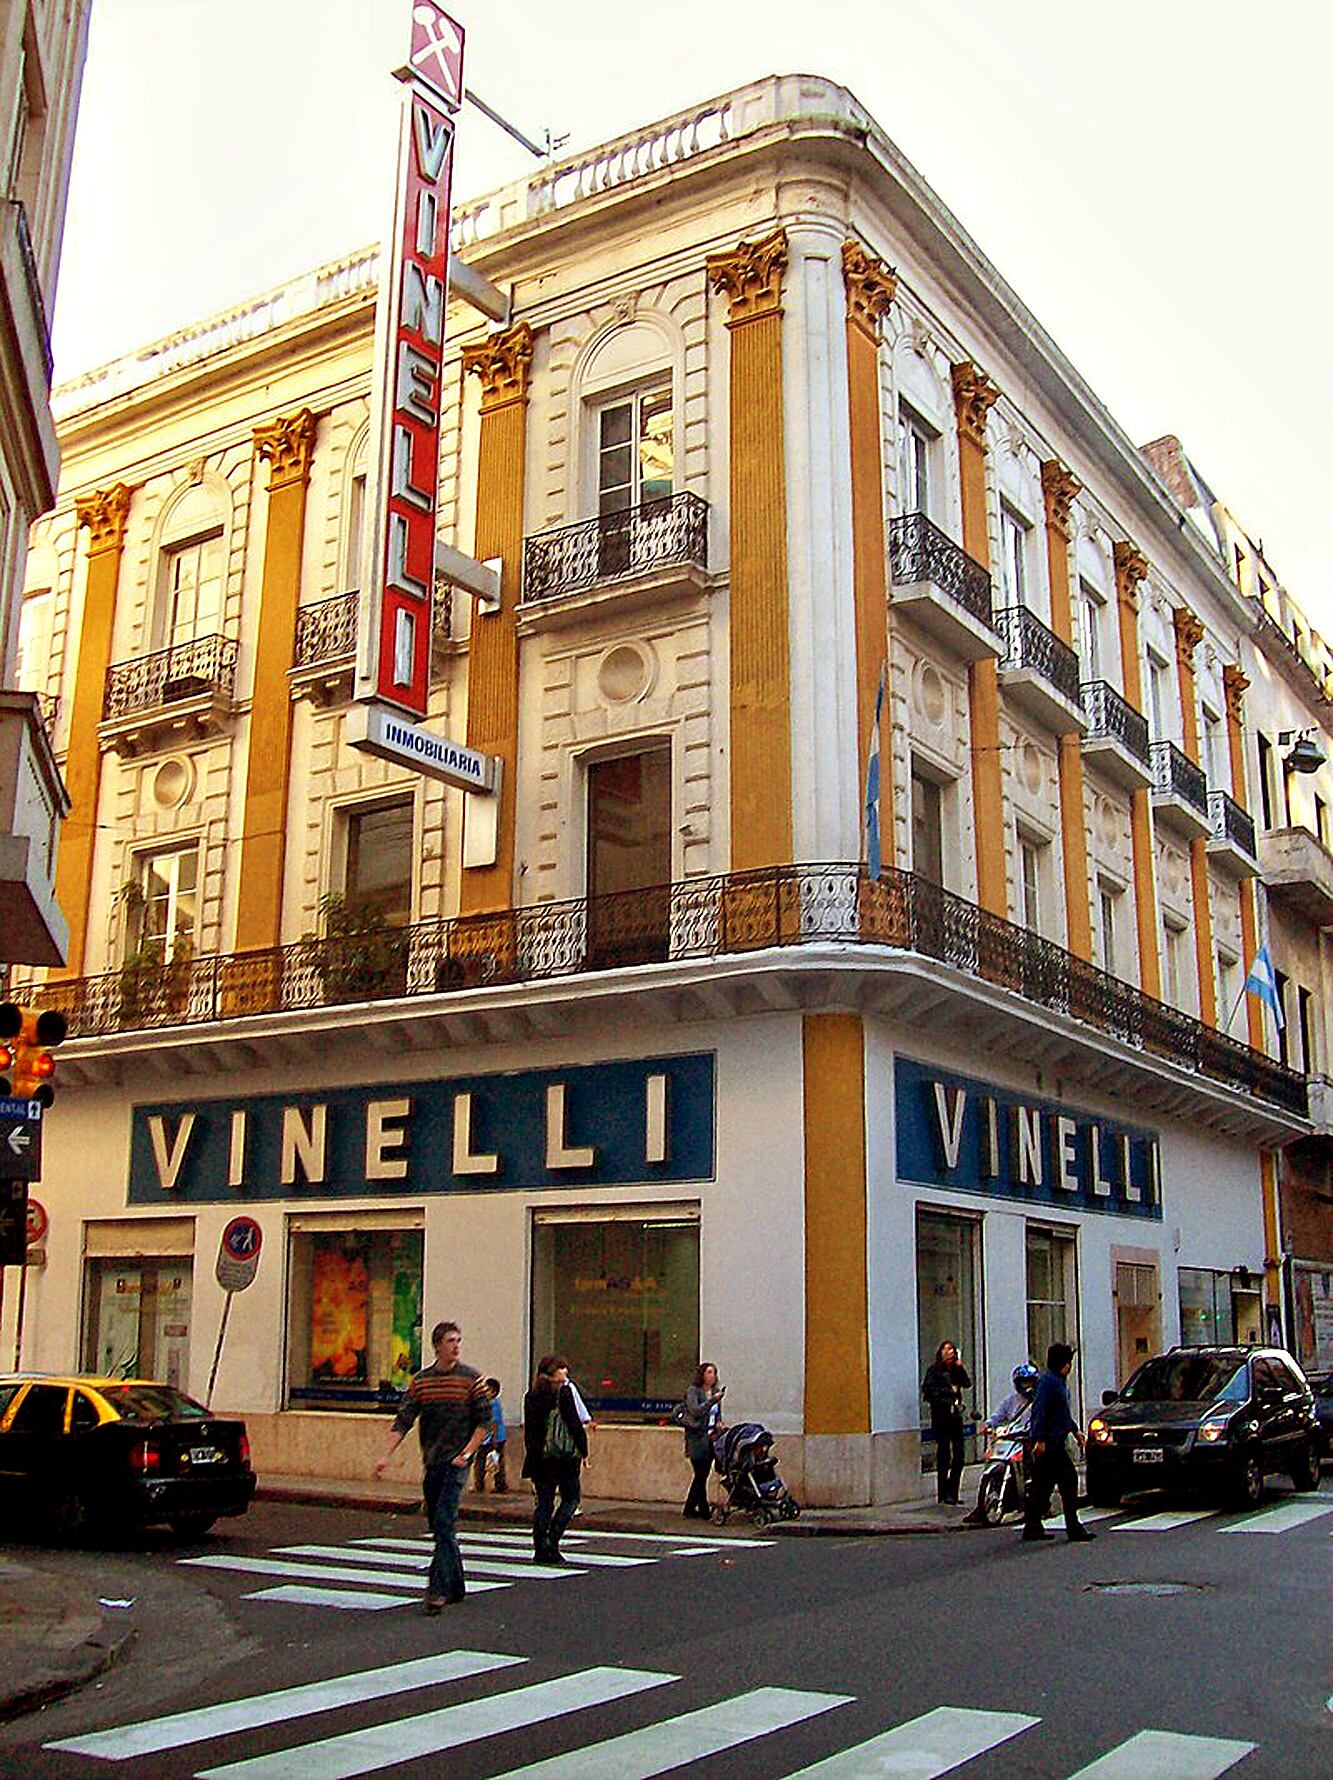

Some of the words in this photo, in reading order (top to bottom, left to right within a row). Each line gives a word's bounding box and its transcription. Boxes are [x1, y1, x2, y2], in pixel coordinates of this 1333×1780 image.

[387, 105, 451, 687] VINELLI
[386, 723, 480, 777] INMOBILIARIA
[148, 1074, 667, 1188] VINELLI
[932, 1082, 1161, 1204] VINELLI
